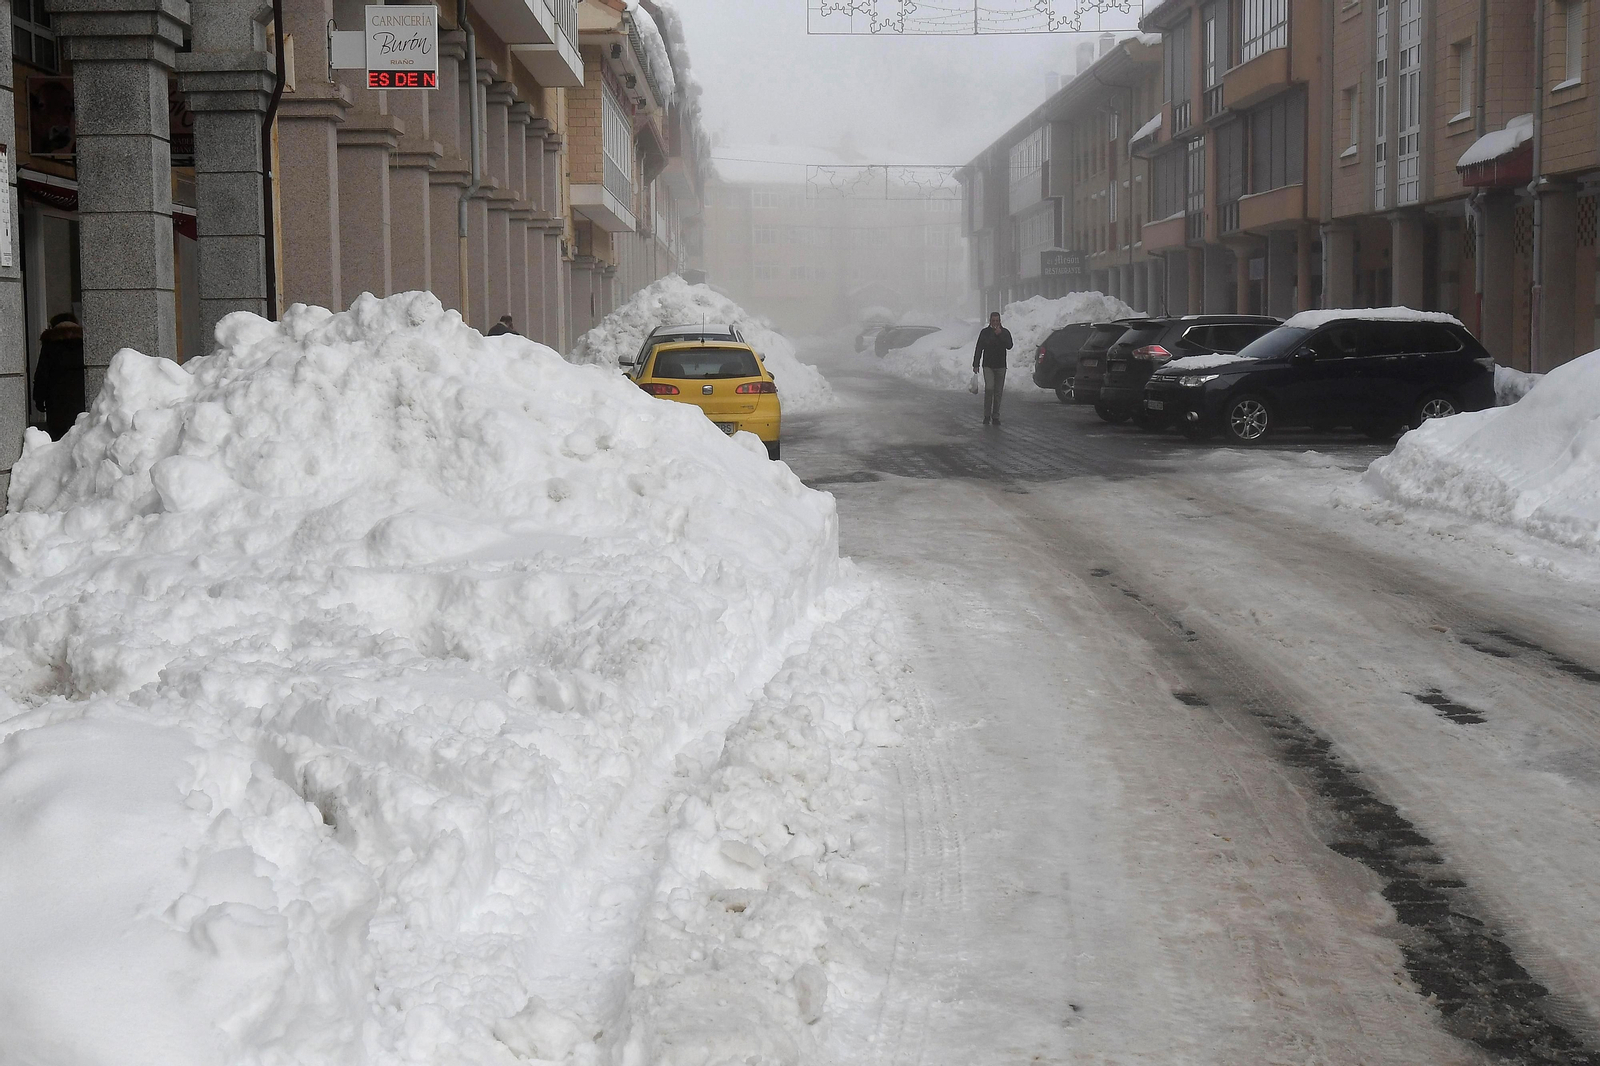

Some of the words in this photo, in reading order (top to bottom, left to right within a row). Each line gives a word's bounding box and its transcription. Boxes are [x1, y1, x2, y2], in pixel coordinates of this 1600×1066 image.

[371, 13, 433, 27] CARNICERÍA
[372, 31, 432, 55] Burón
[368, 72, 390, 87] ES
[395, 72, 418, 87] DE
[423, 72, 436, 87] N
[1044, 266, 1082, 276] RESTAURANTE
[719, 423, 732, 433] BS
